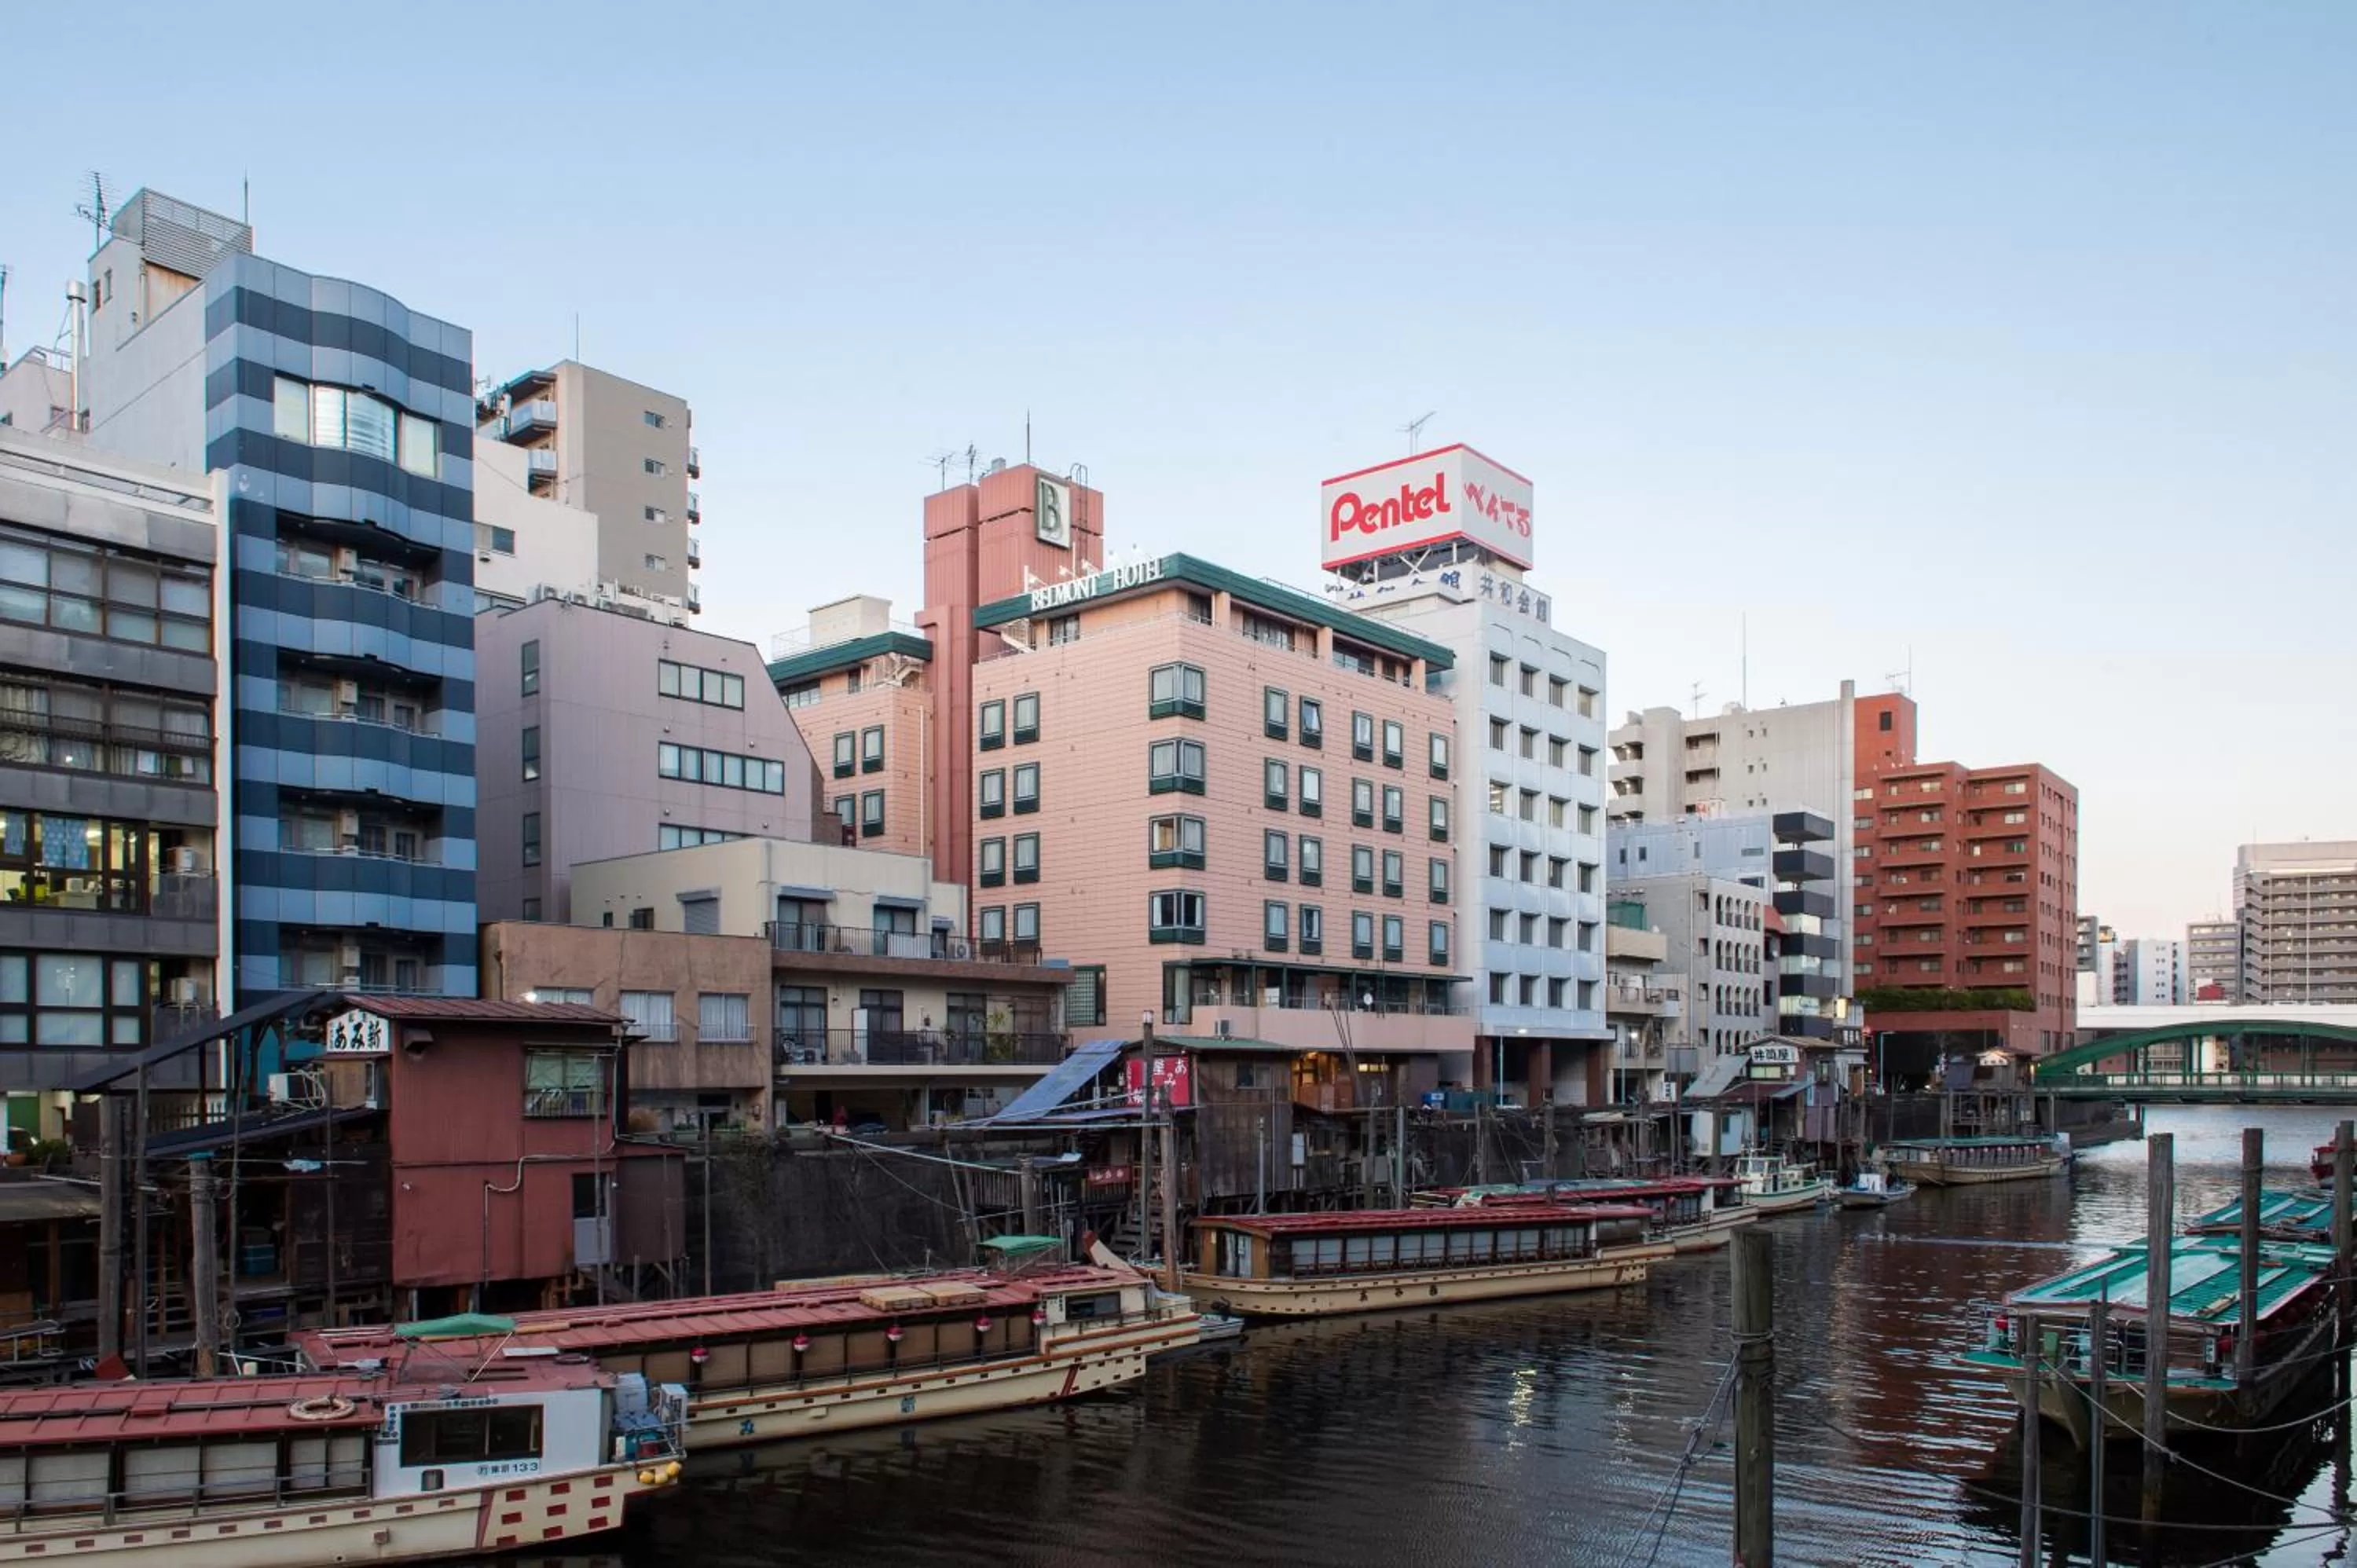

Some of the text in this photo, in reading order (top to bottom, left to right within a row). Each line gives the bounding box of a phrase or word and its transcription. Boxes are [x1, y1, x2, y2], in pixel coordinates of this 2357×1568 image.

[1041, 481, 1061, 531] B
[1330, 472, 1450, 541] Pentel
[1464, 481, 1530, 538] ぺんてる
[1031, 557, 1164, 612] BELMONT HOTEL
[335, 1021, 382, 1050] あみ新
